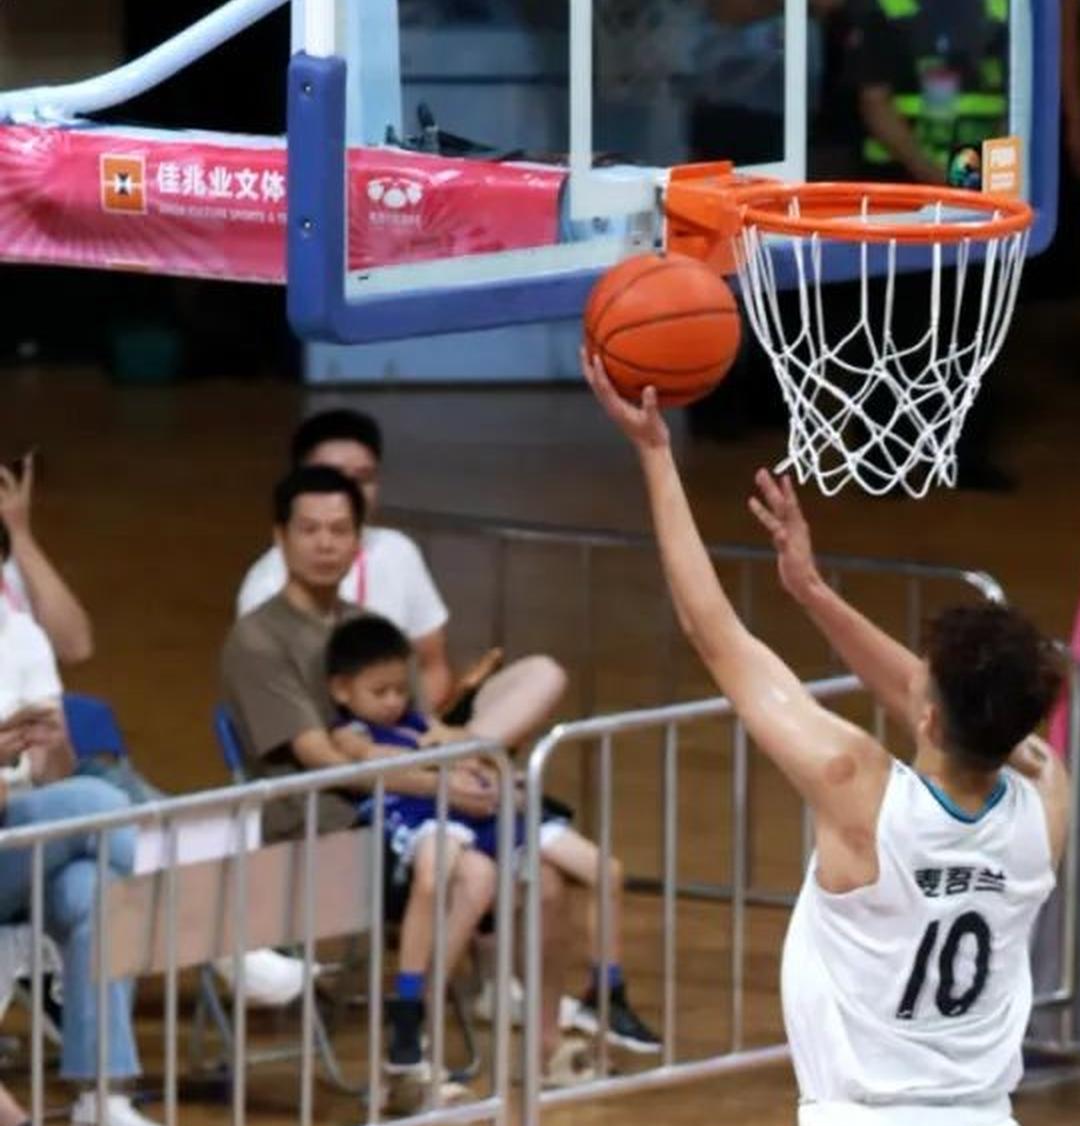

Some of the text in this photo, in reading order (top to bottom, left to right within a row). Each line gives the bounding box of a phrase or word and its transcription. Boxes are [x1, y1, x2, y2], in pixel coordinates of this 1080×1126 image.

[157, 161, 287, 203] 佳兆业文体
[894, 910, 992, 1021] 10
